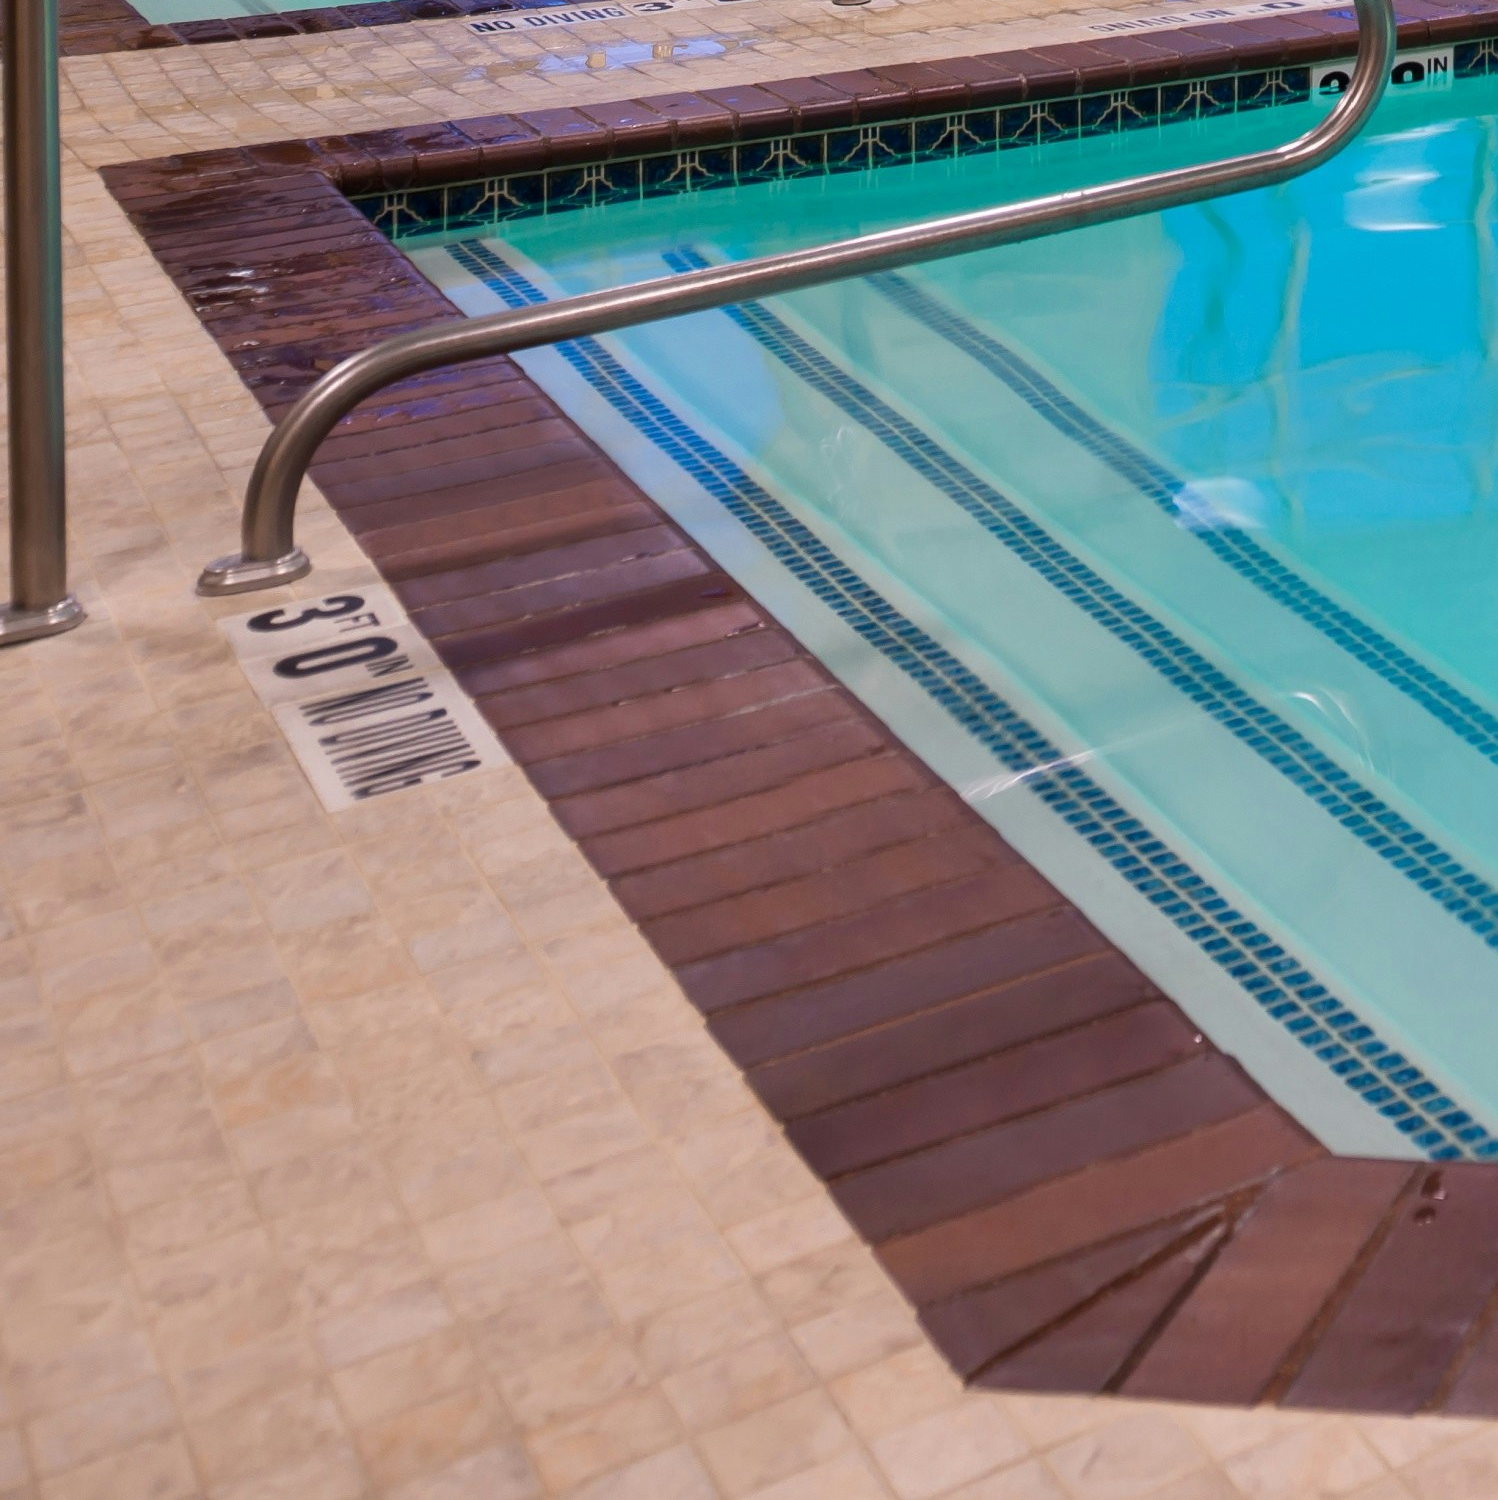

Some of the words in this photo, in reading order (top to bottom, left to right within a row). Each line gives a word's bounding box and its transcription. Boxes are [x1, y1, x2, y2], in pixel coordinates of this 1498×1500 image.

[470, 20, 515, 33] NO
[524, 7, 625, 27] DIVING
[298, 676, 434, 727] NO
[318, 707, 482, 800] DIVING
